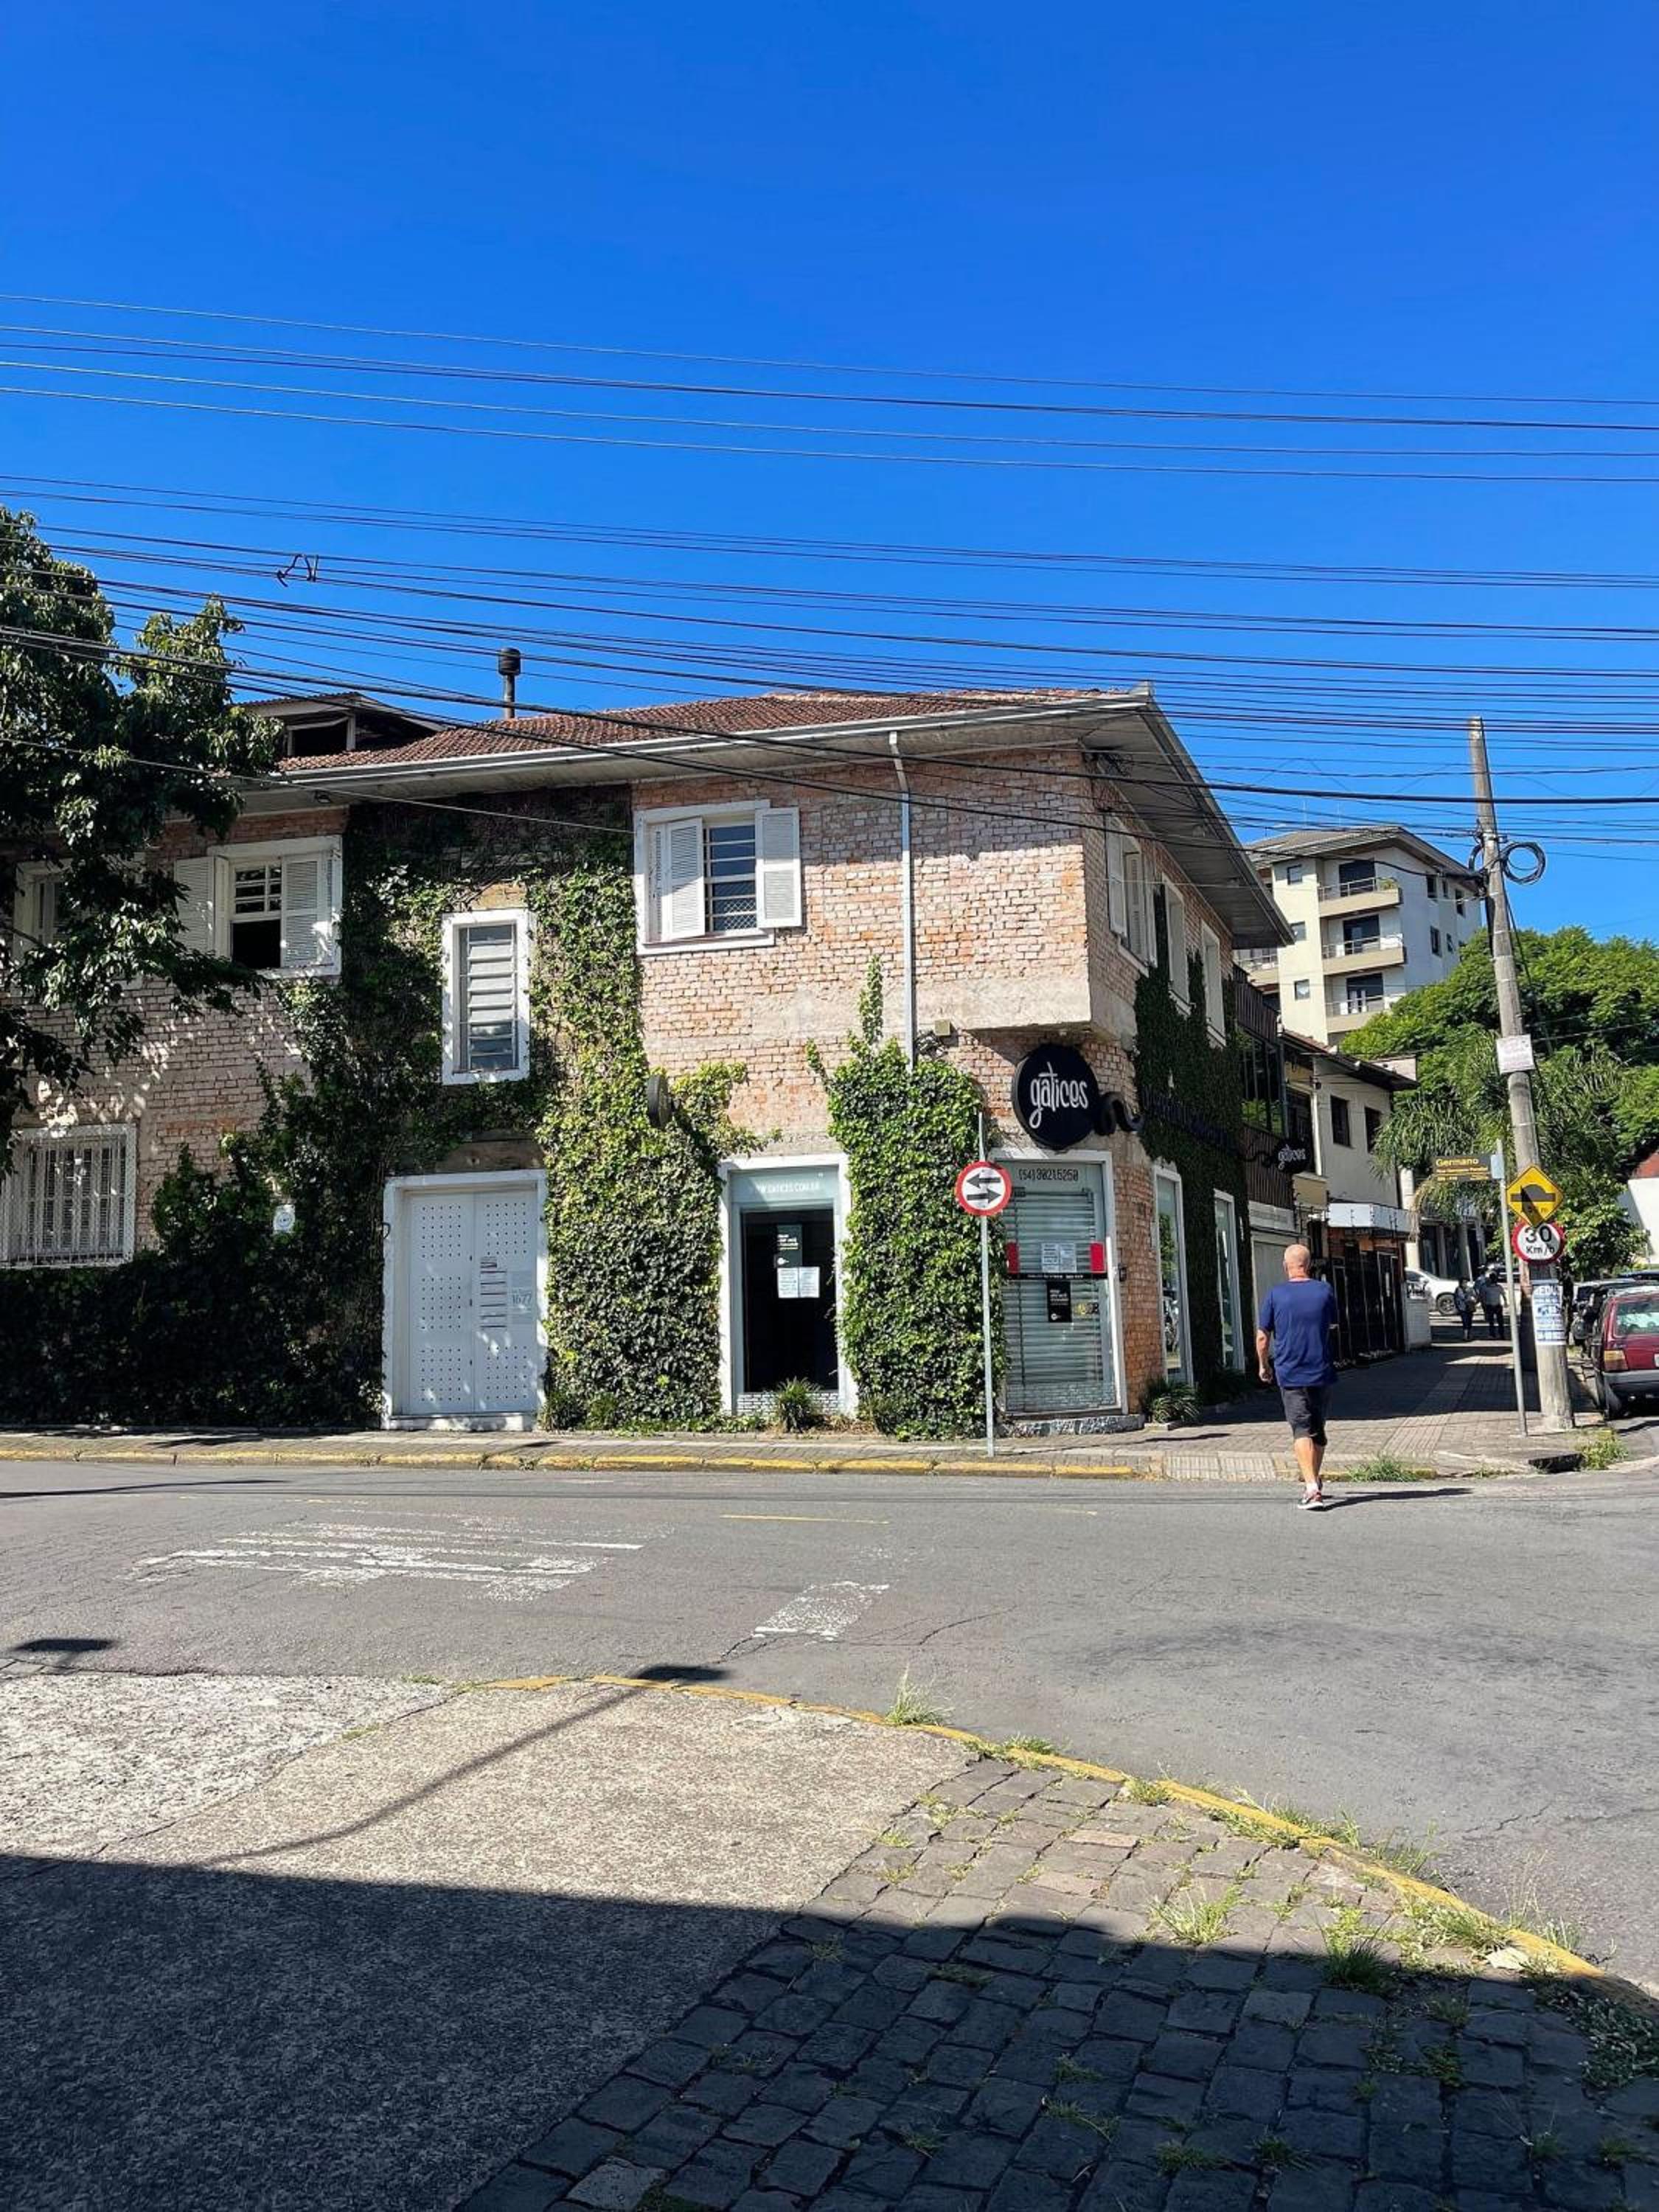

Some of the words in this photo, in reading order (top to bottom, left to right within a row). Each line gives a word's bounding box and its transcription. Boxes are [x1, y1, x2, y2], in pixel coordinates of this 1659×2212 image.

[1029, 1061, 1089, 1129] gatices
[1435, 1158, 1479, 1166] Germano
[1525, 1225, 1553, 1243] 30
